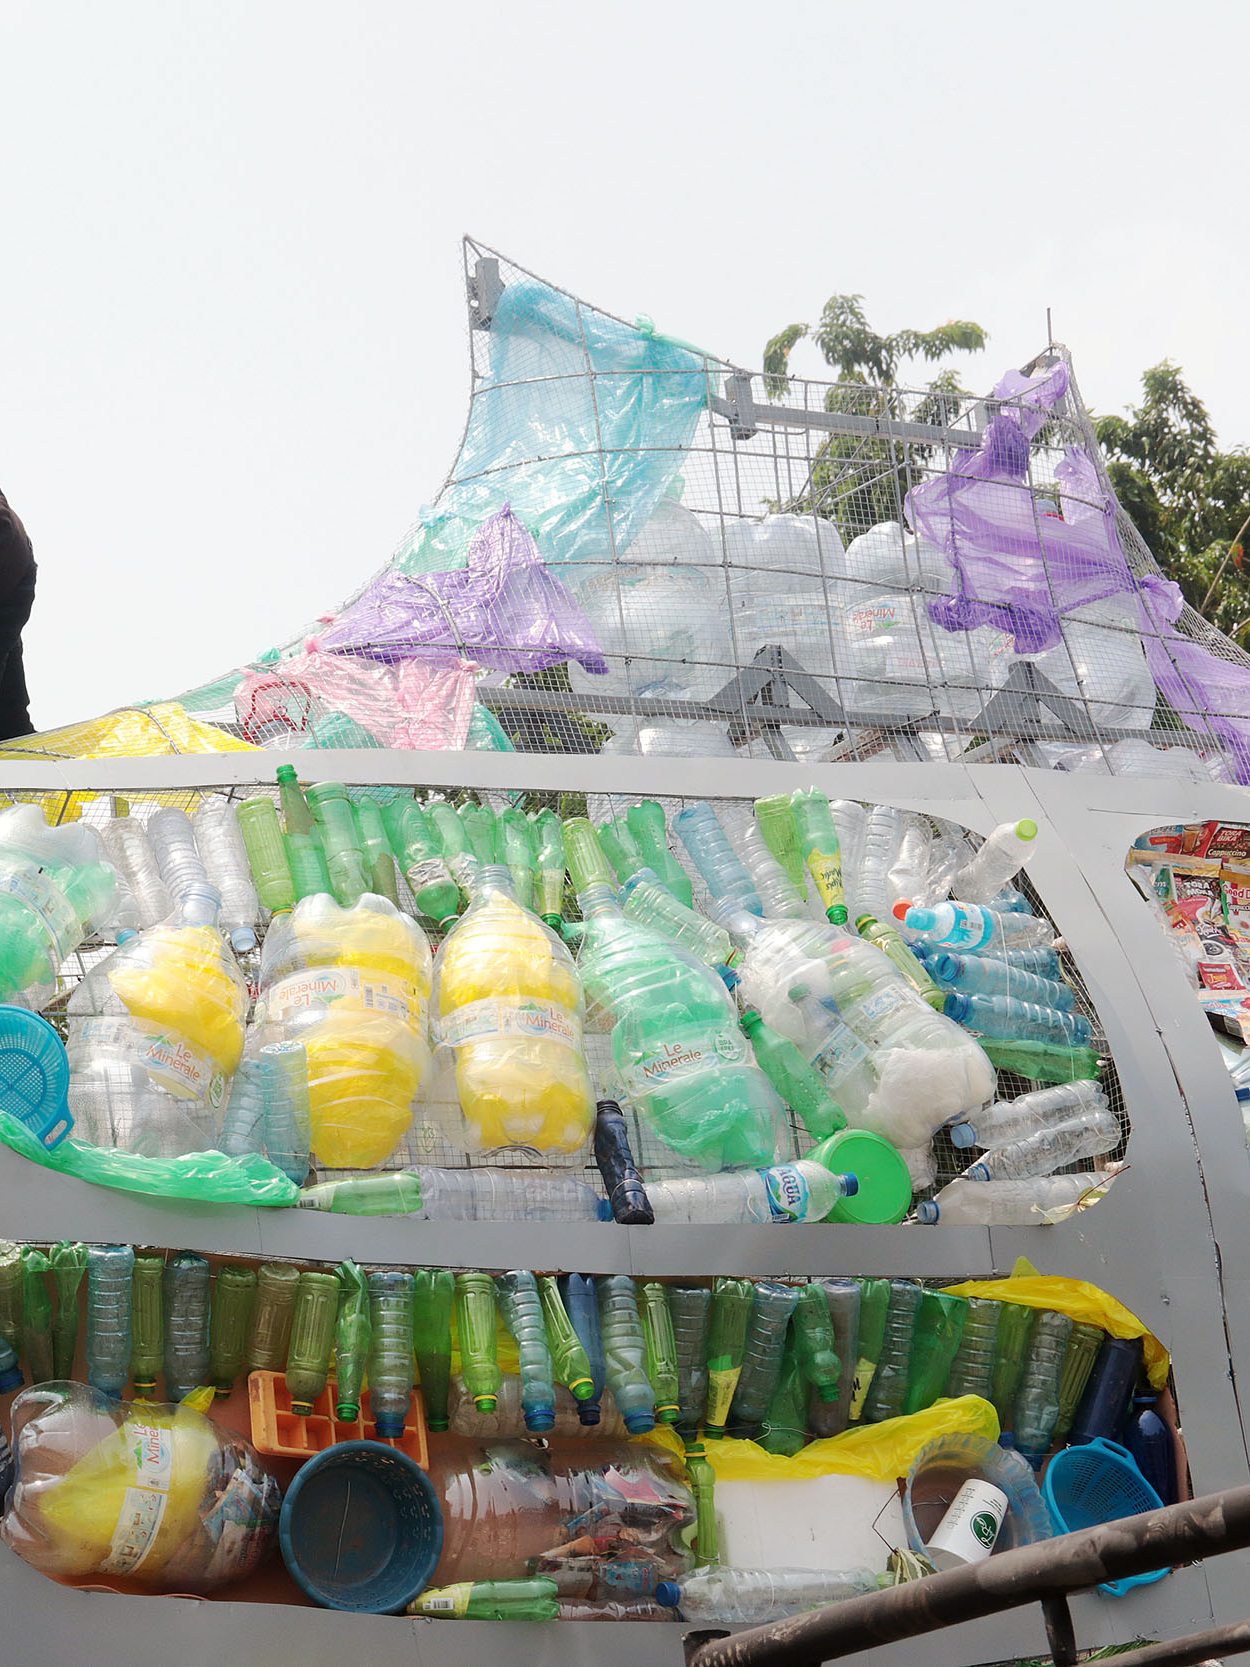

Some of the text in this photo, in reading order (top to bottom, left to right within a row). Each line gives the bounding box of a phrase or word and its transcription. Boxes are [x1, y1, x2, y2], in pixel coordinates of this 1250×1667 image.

[1207, 849, 1247, 857] Cappuccino
[279, 979, 337, 1000] Minerale
[294, 993, 310, 1006] Le
[550, 1007, 563, 1021] Le
[526, 1014, 575, 1040] Minerale
[176, 1043, 191, 1061] Le
[663, 1043, 682, 1057] Le
[145, 1045, 200, 1081] Minerale
[642, 1049, 703, 1078] Minerale
[779, 1169, 801, 1206] AQUA
